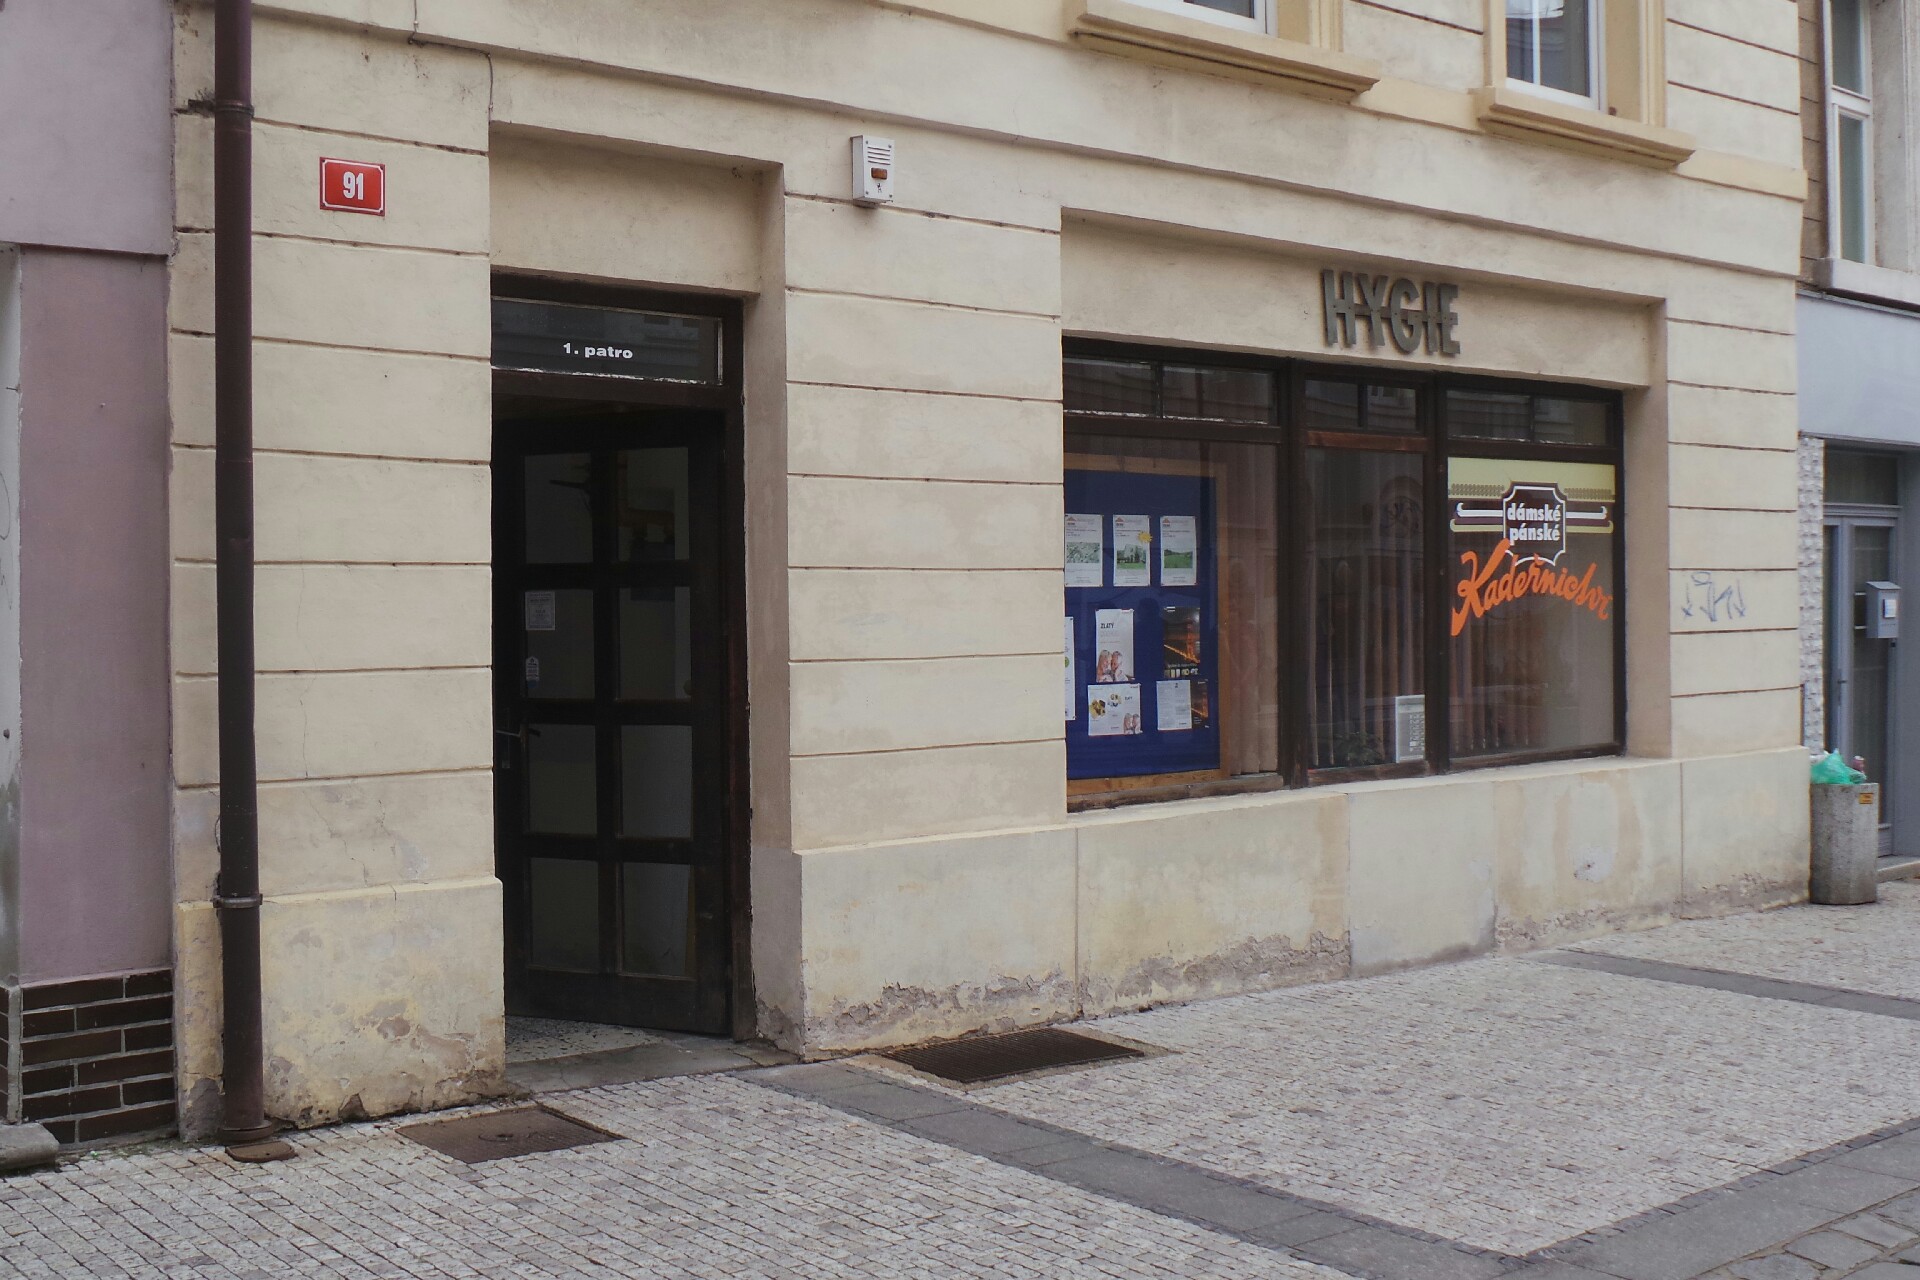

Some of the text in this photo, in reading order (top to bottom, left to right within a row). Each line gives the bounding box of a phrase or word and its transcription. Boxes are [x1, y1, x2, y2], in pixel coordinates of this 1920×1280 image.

[343, 171, 364, 201] 91
[1321, 268, 1461, 356] HYGIE
[563, 342, 634, 359] 1. patro
[1507, 502, 1562, 522] dámské
[1509, 523, 1561, 546] pánské
